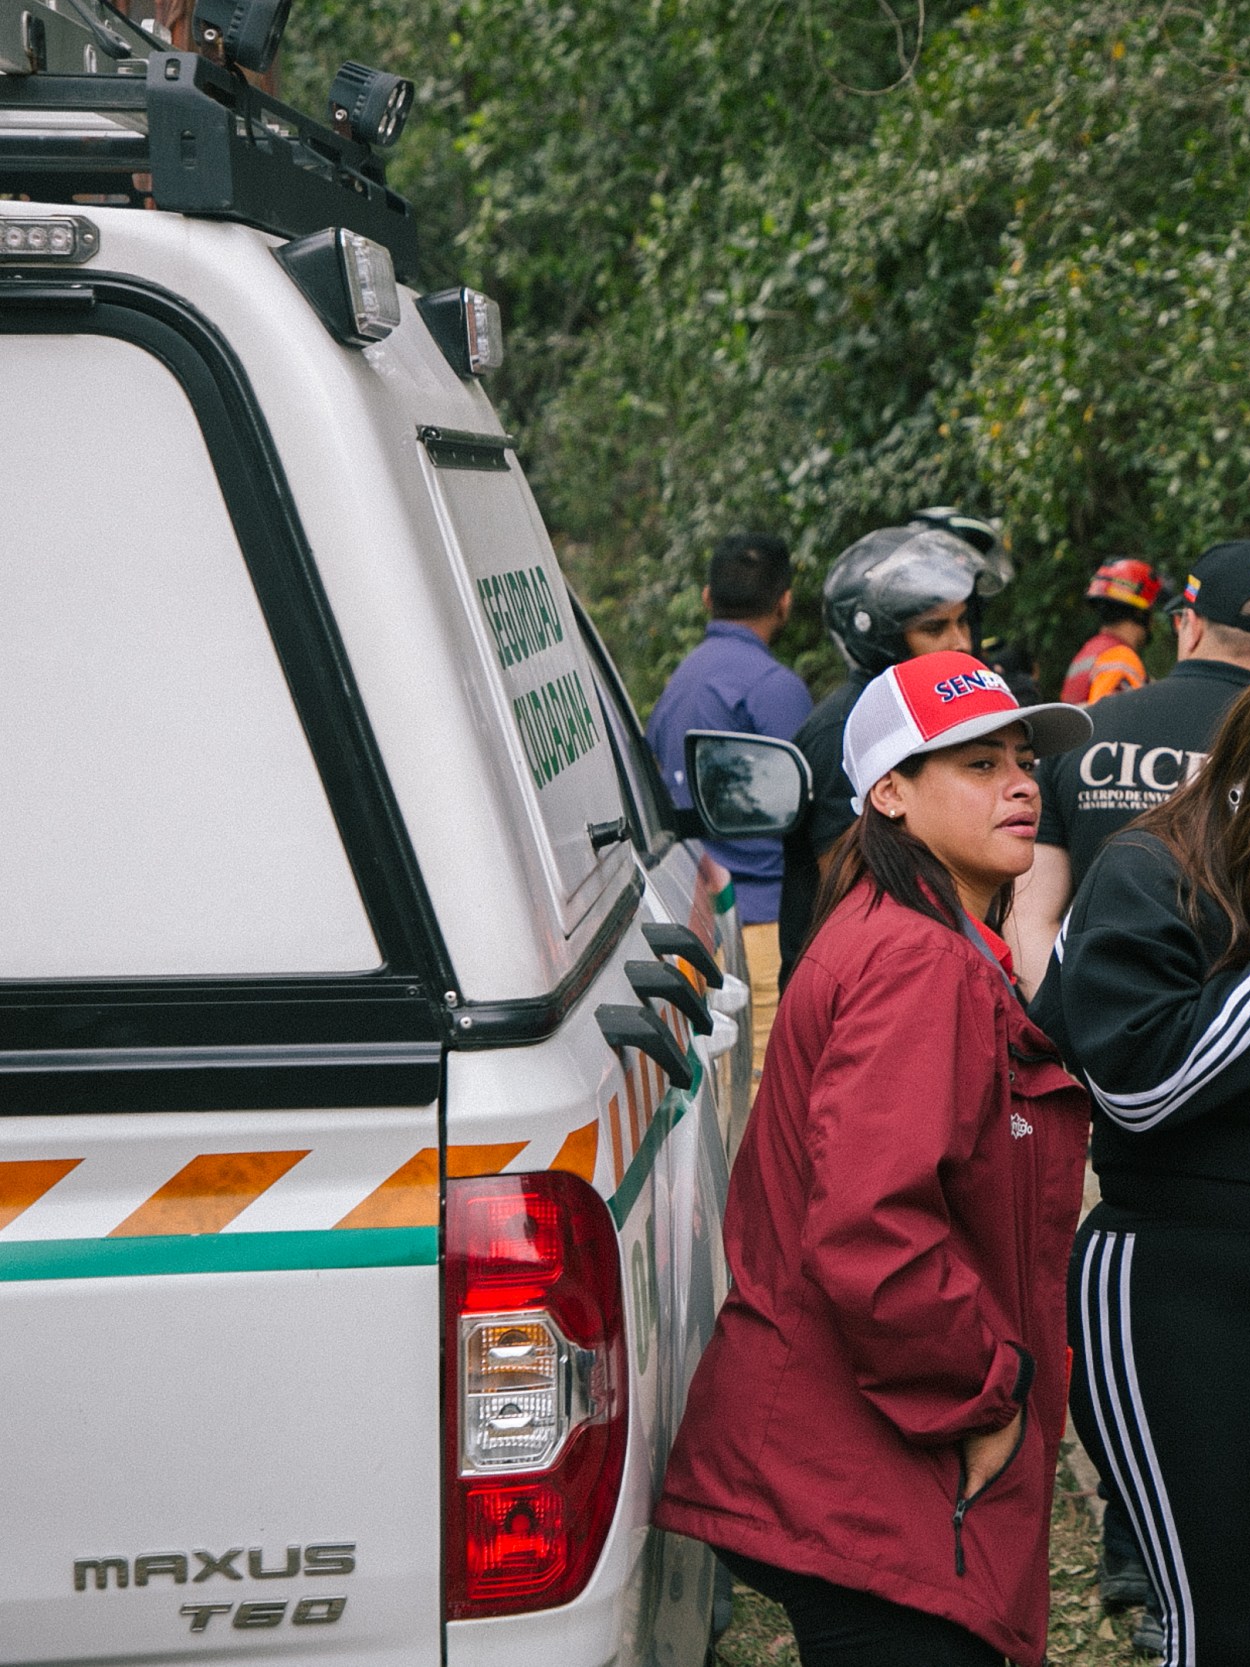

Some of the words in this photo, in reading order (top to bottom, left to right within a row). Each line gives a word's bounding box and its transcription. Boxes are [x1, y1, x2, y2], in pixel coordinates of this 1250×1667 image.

[476, 565, 563, 671] SEGURIDAD
[513, 669, 600, 791] CIUDADANA
[1078, 789, 1124, 802] CUERPO
[1125, 790, 1142, 802] DE
[73, 1540, 356, 1592] MAXUS
[179, 1594, 347, 1633] T60
